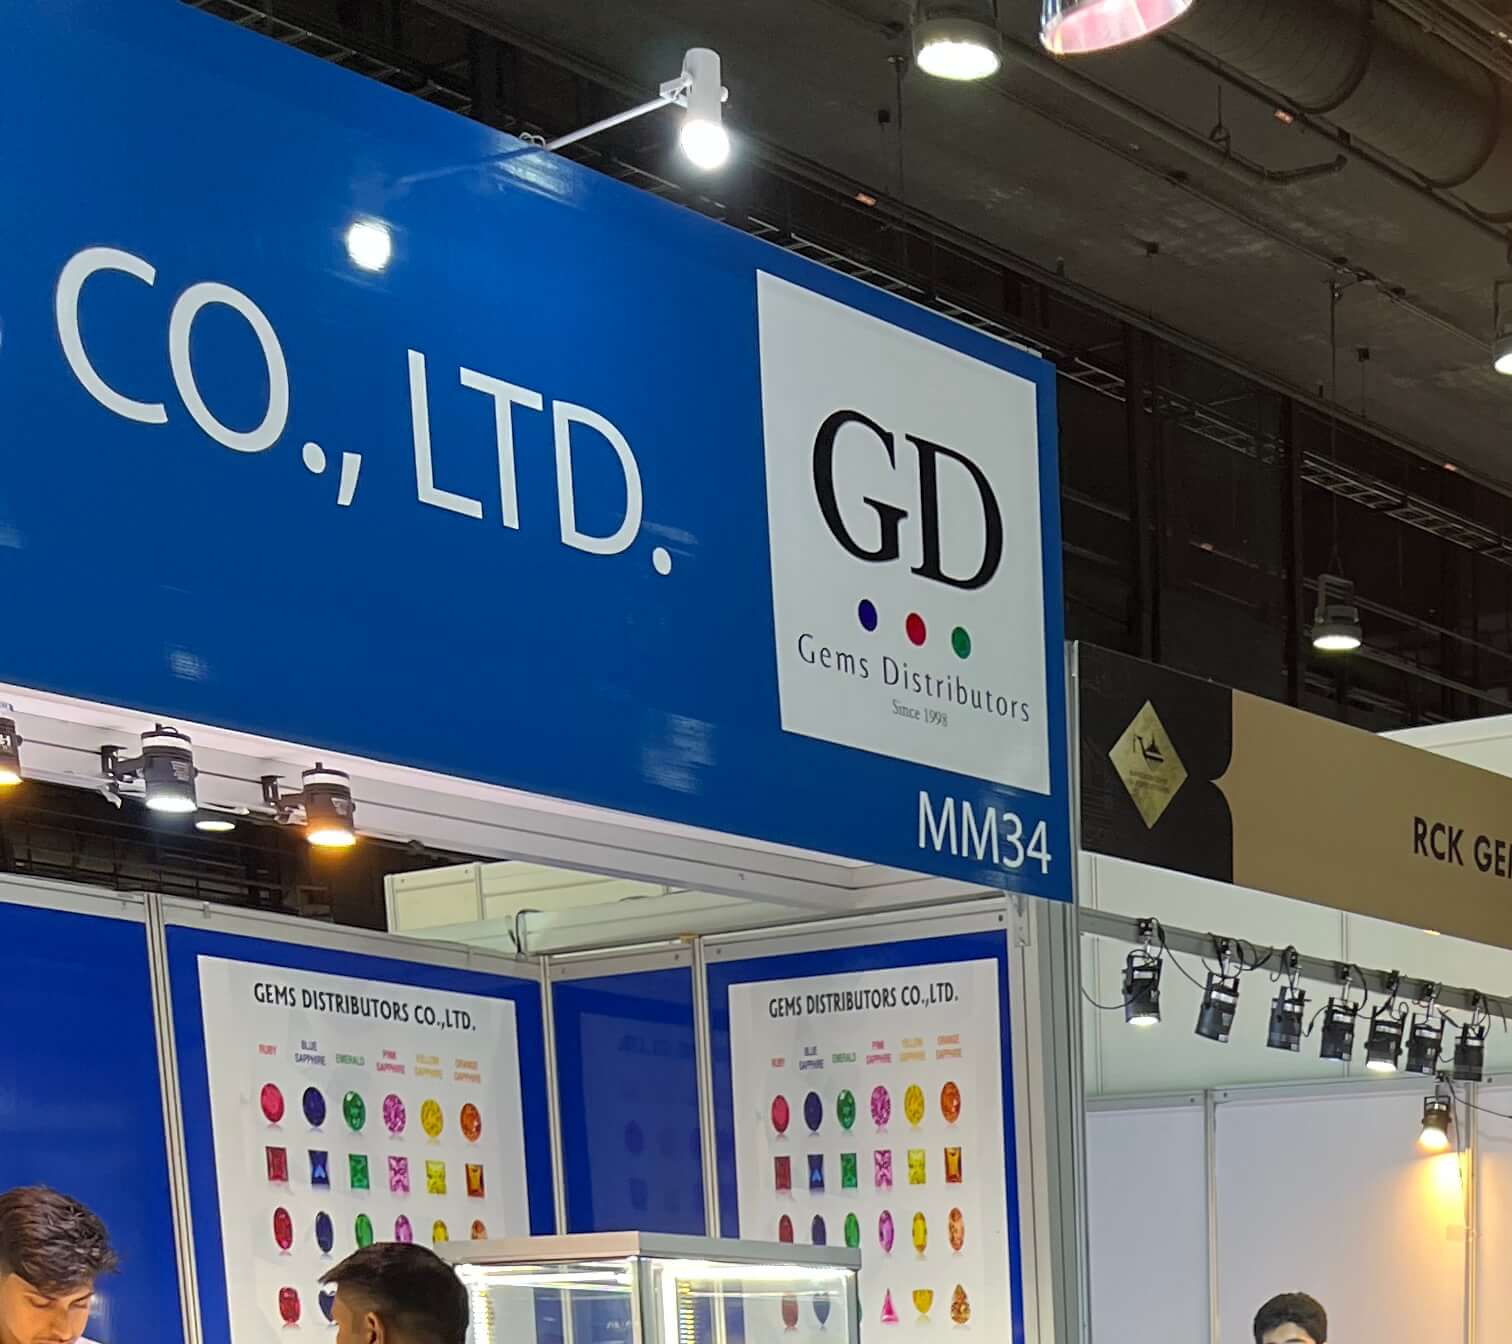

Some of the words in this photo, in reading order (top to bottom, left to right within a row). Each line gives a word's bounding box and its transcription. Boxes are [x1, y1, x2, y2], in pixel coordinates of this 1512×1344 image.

[56, 246, 362, 506] CO.,
[407, 349, 671, 576] LTD.
[812, 408, 1003, 590] GD
[798, 633, 869, 679] Gems
[882, 656, 1030, 722] Distributors
[892, 699, 921, 720] Since
[924, 708, 948, 727] 1998
[919, 790, 1052, 875] MM34
[1414, 816, 1465, 866] RCK
[254, 982, 296, 1007] GEMS
[302, 988, 409, 1022] DISTRIBUTORS
[768, 995, 802, 1018] GEMS
[806, 986, 896, 1015] DISTRIBUTORS
